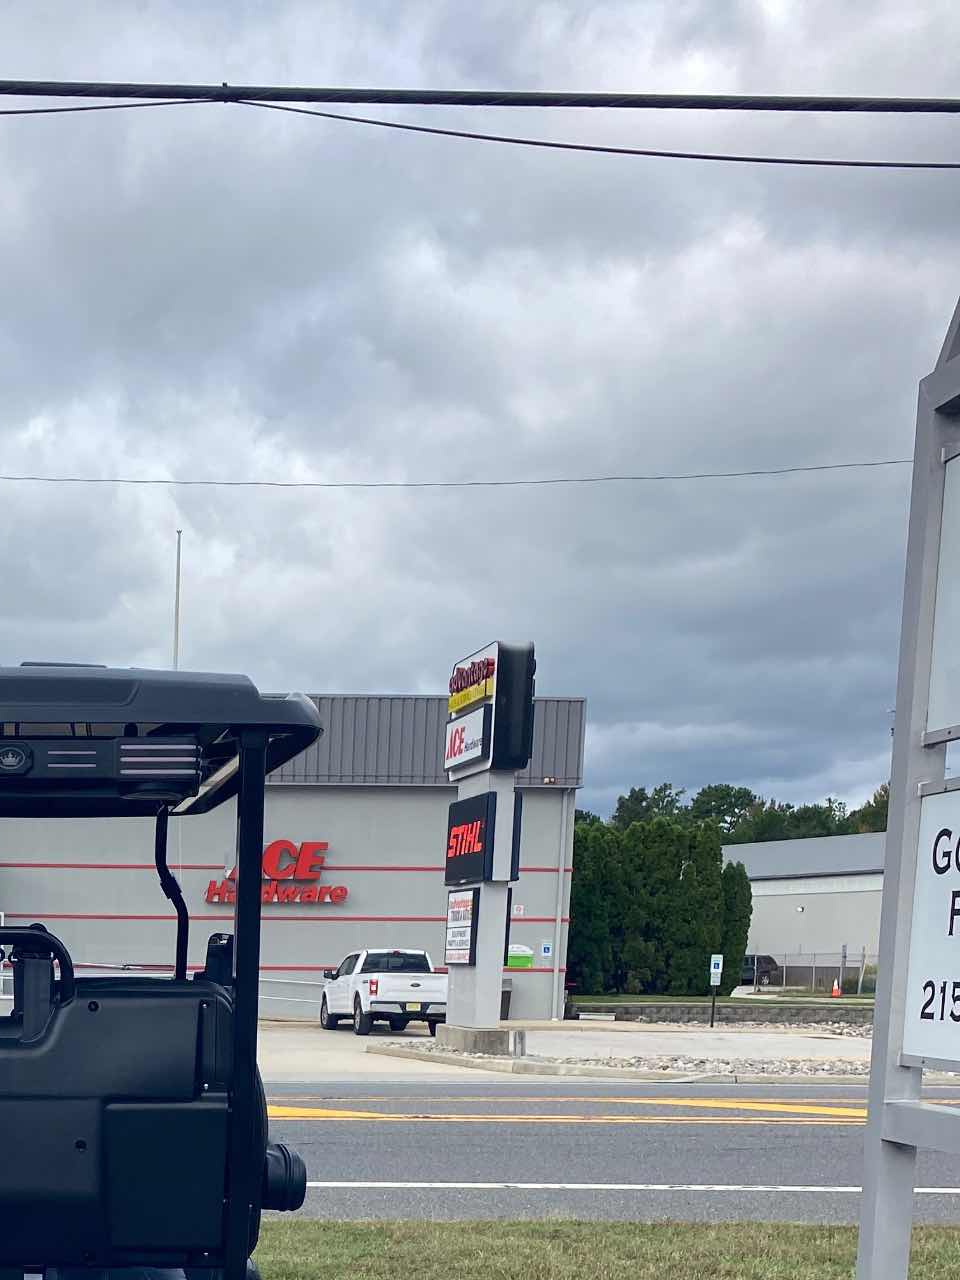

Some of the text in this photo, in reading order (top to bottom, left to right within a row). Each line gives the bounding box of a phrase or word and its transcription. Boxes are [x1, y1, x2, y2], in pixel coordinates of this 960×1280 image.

[446, 726, 465, 760] ACE
[447, 820, 482, 857] STIHL
[932, 828, 960, 874] G
[226, 840, 329, 880] CE
